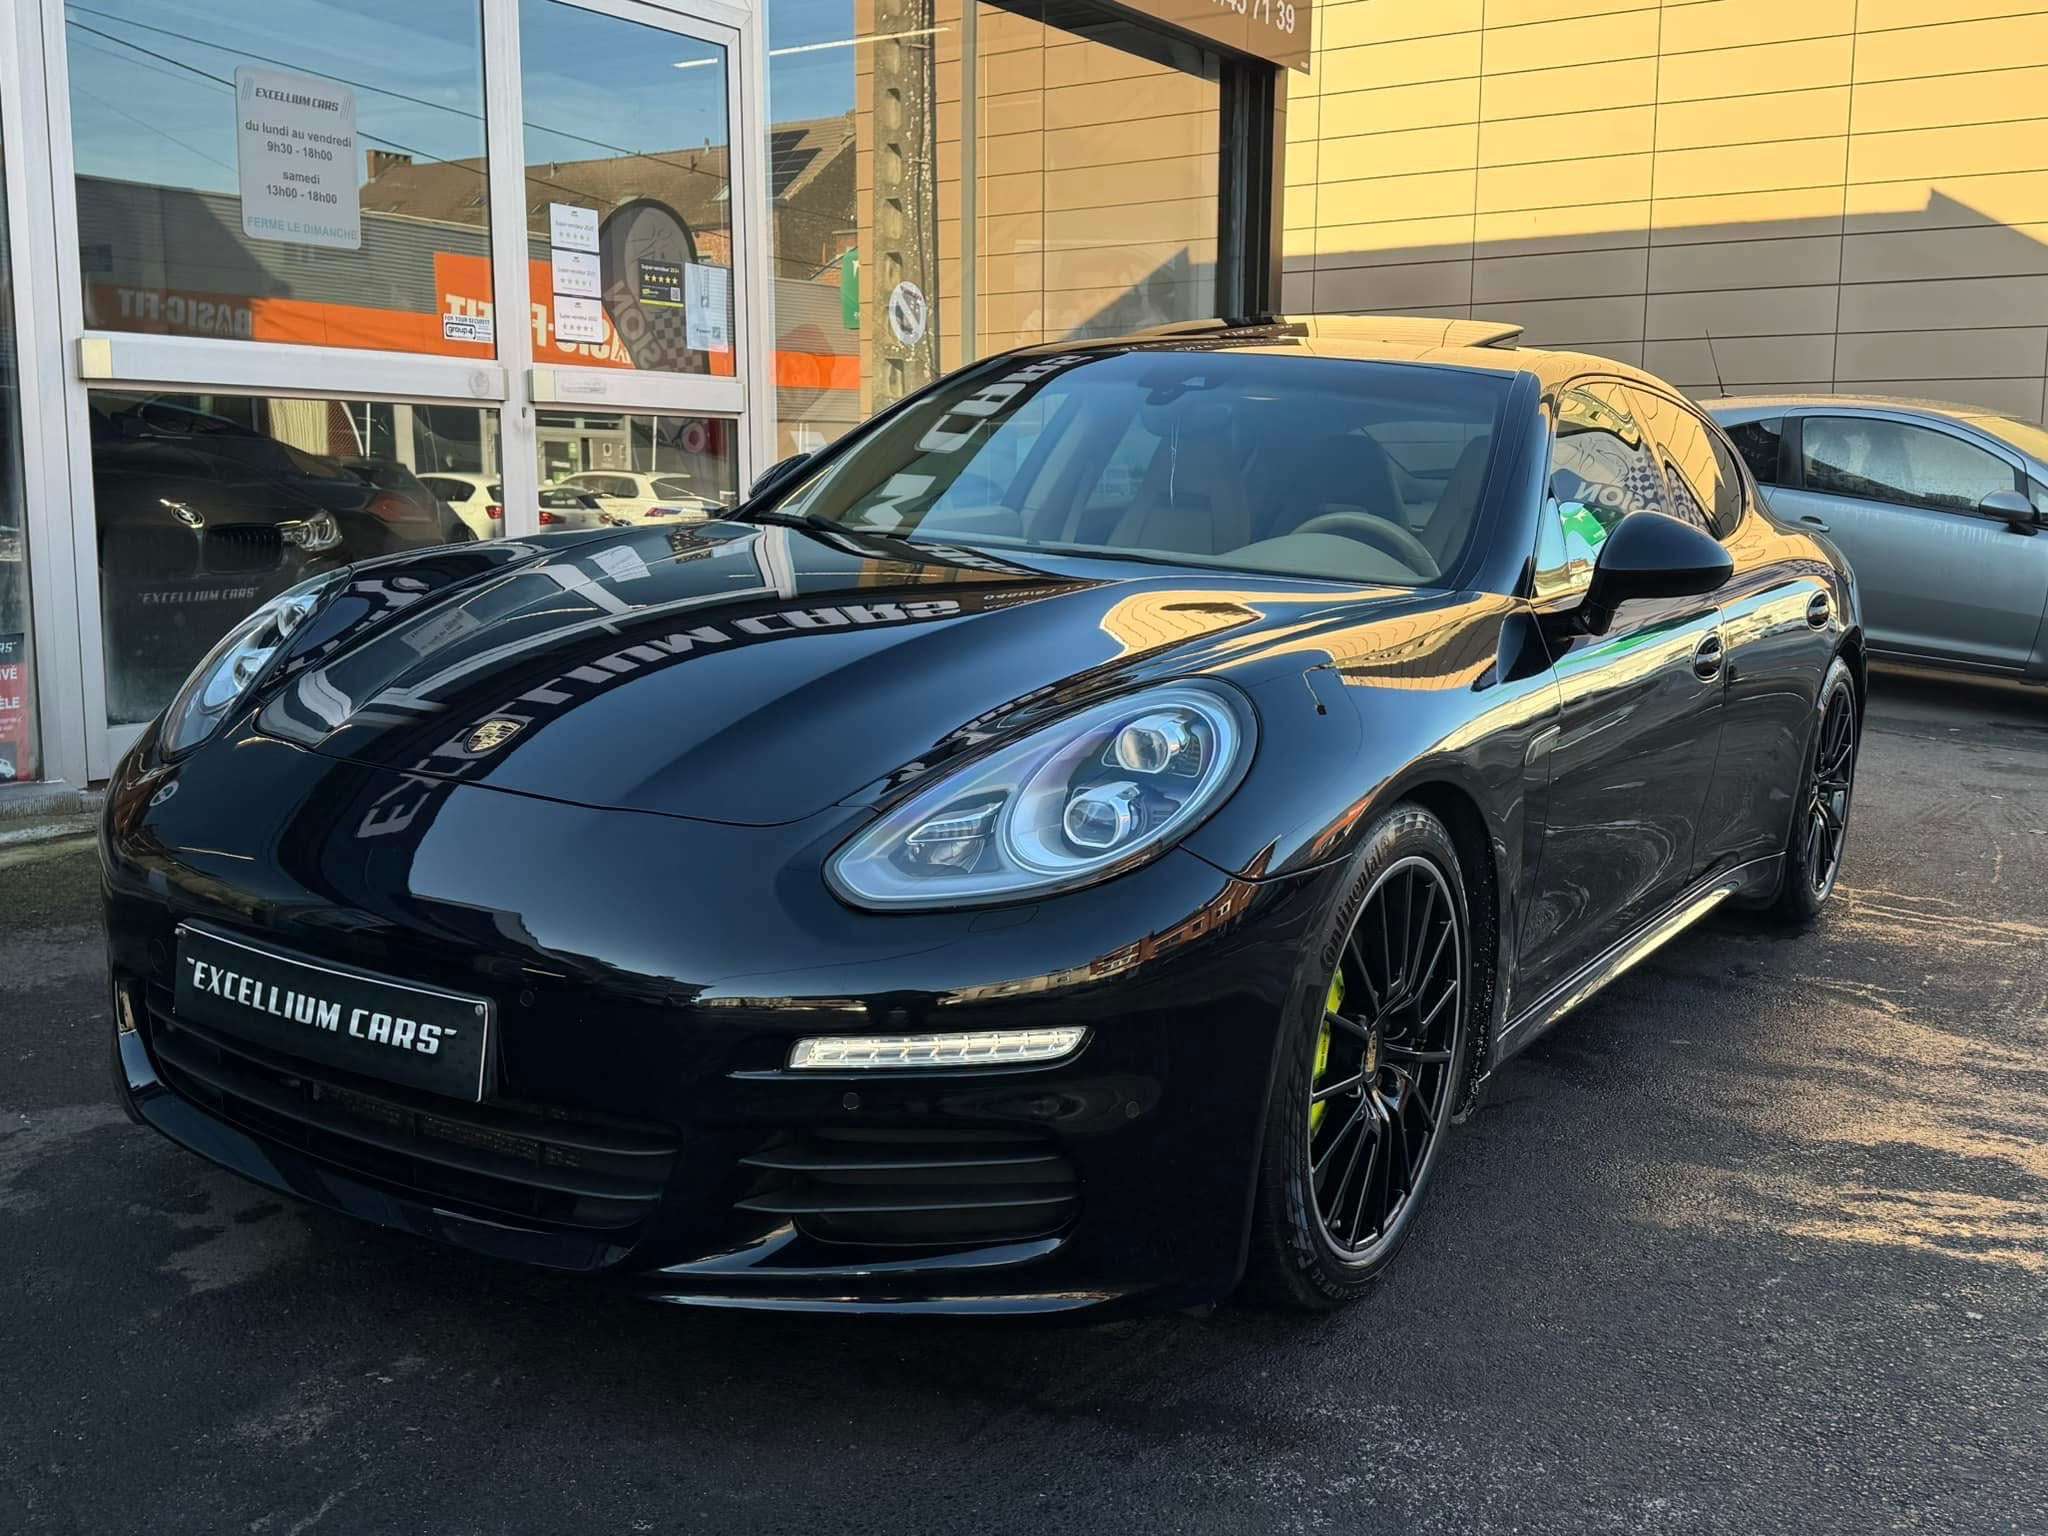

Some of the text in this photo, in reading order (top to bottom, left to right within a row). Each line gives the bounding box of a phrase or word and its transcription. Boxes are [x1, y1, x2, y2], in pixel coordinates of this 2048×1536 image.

[1276, 0, 1295, 34] 39
[255, 87, 340, 112] EXCELLIUM CARS
[245, 120, 352, 148] du lundi au vendredi
[267, 141, 293, 155] 9h30
[303, 147, 333, 161] 18h00
[282, 171, 320, 185] samedi
[266, 184, 298, 199] 13h00
[308, 190, 338, 205] 18h00
[287, 221, 301, 233] LE
[303, 223, 359, 240] DIMANCHE
[190, 959, 446, 1056] EXCELLIUM CARS
